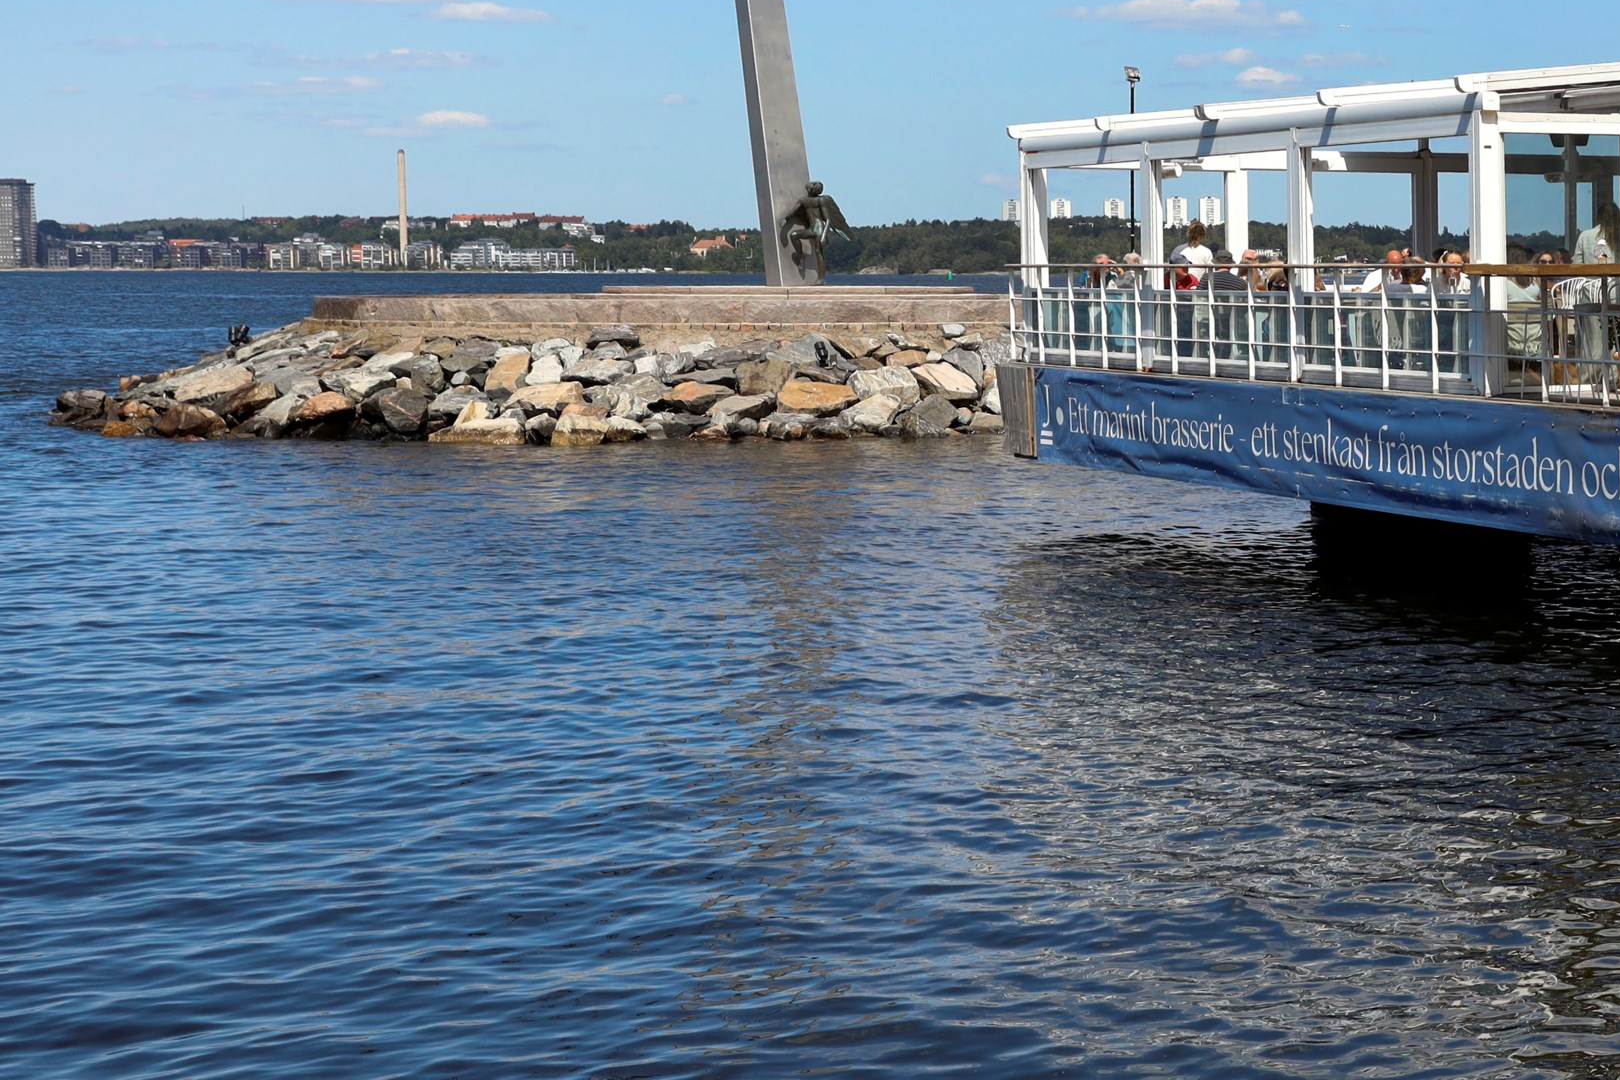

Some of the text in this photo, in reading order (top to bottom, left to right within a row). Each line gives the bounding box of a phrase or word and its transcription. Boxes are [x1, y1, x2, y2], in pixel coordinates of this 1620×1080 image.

[1068, 397, 1090, 435] Ett
[1093, 404, 1149, 444] marint
[1151, 401, 1235, 453] brasserie
[1251, 422, 1280, 459] ett
[1283, 417, 1374, 472] stenkast
[1377, 424, 1427, 478] från
[1432, 437, 1575, 496] storstaden
